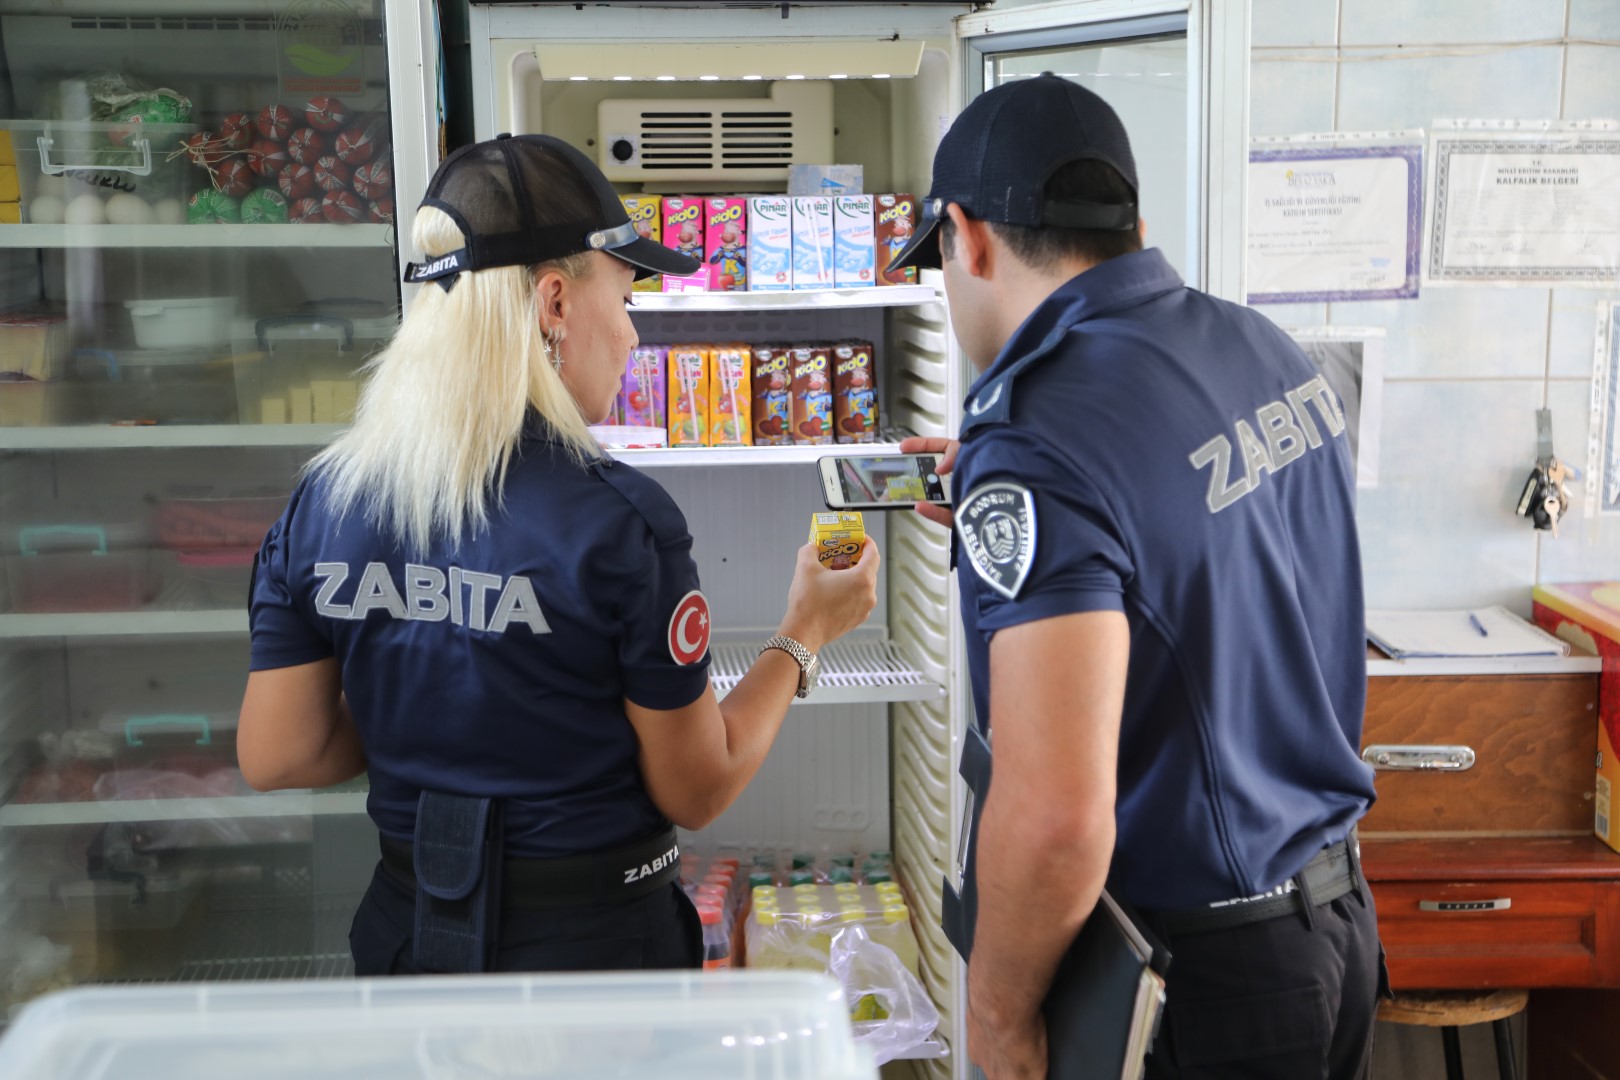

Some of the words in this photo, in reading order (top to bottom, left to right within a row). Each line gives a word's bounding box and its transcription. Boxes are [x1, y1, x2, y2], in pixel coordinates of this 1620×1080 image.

[416, 255, 458, 278] ZABITA
[968, 493, 1015, 519] BODRUM
[314, 562, 553, 634] ZABITA
[624, 844, 680, 884] ZABITA
